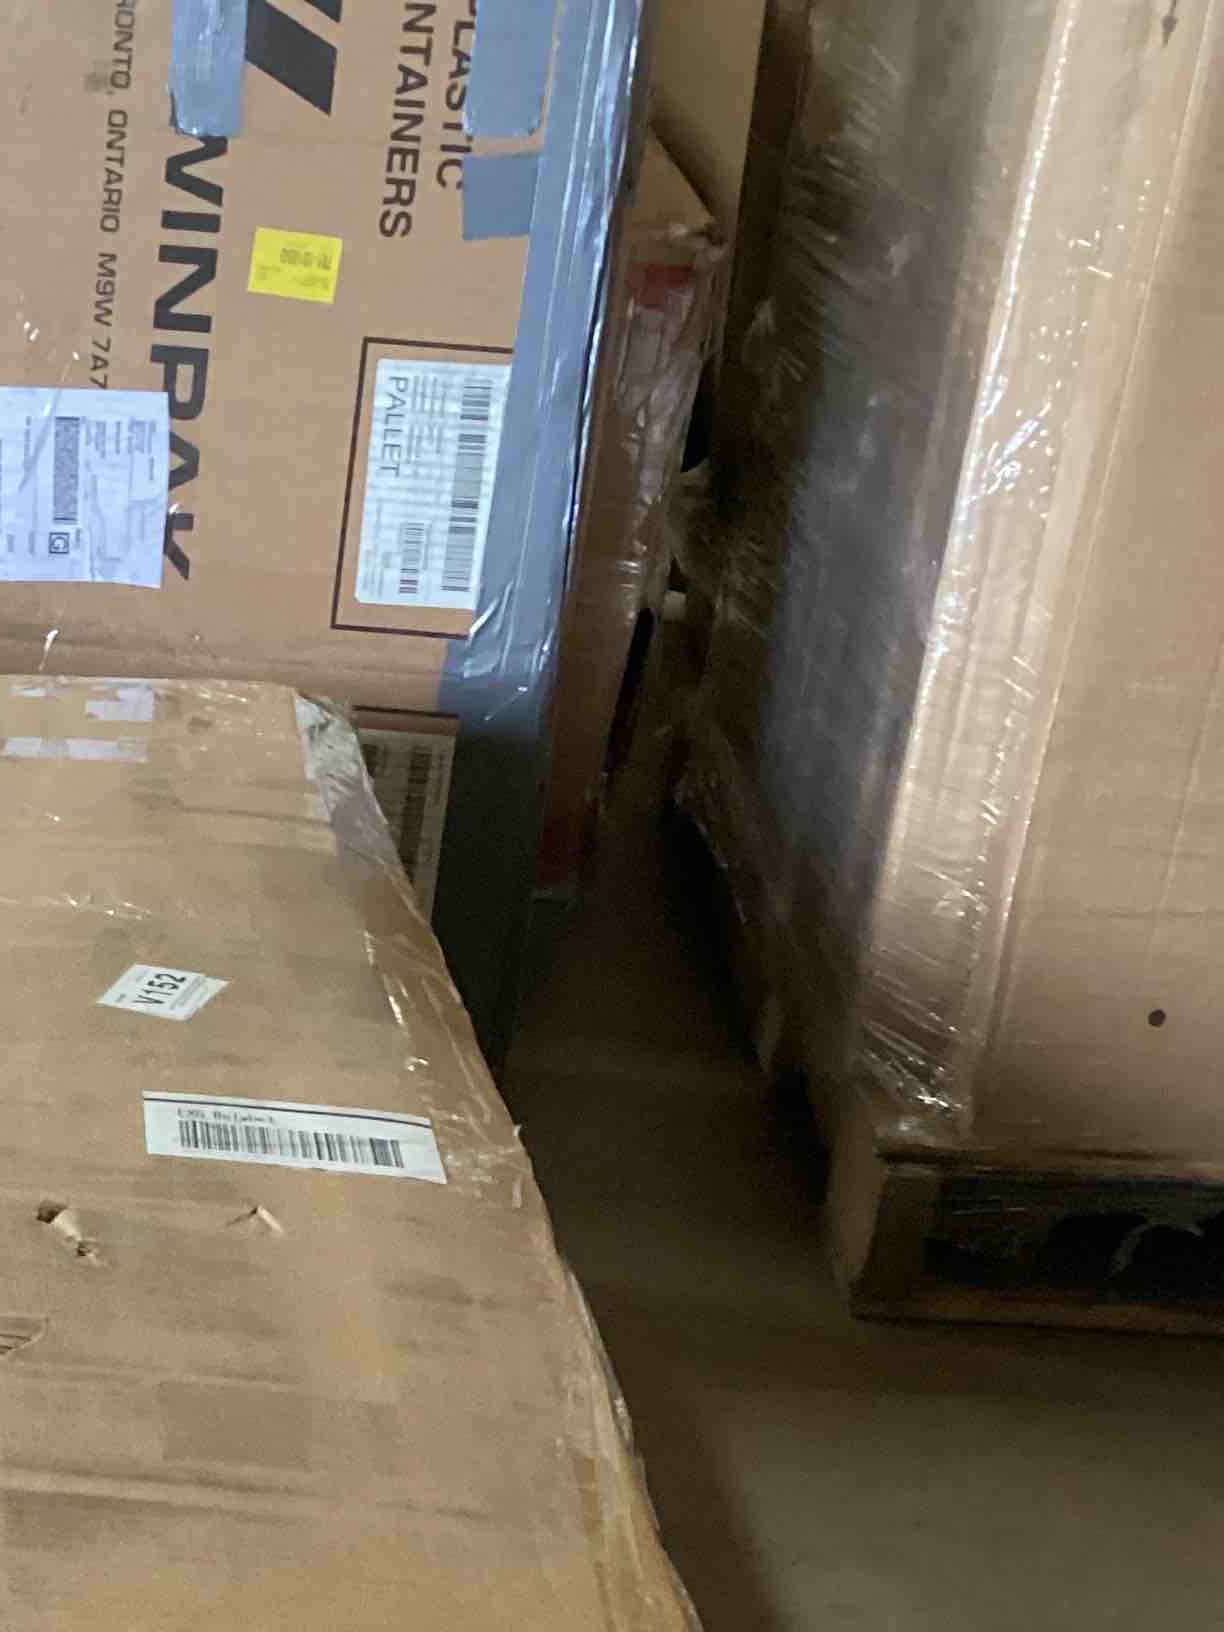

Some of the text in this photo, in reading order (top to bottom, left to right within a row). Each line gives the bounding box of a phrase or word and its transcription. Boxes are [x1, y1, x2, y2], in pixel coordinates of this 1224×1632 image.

[379, 2, 437, 238] NTAINERS
[436, 0, 478, 190] LASTIC
[99, 109, 128, 233] ONTARIO
[93, 252, 117, 327] M9W
[89, 336, 111, 389] 7A7
[379, 376, 408, 477] PALLET
[132, 973, 187, 1005] V152
